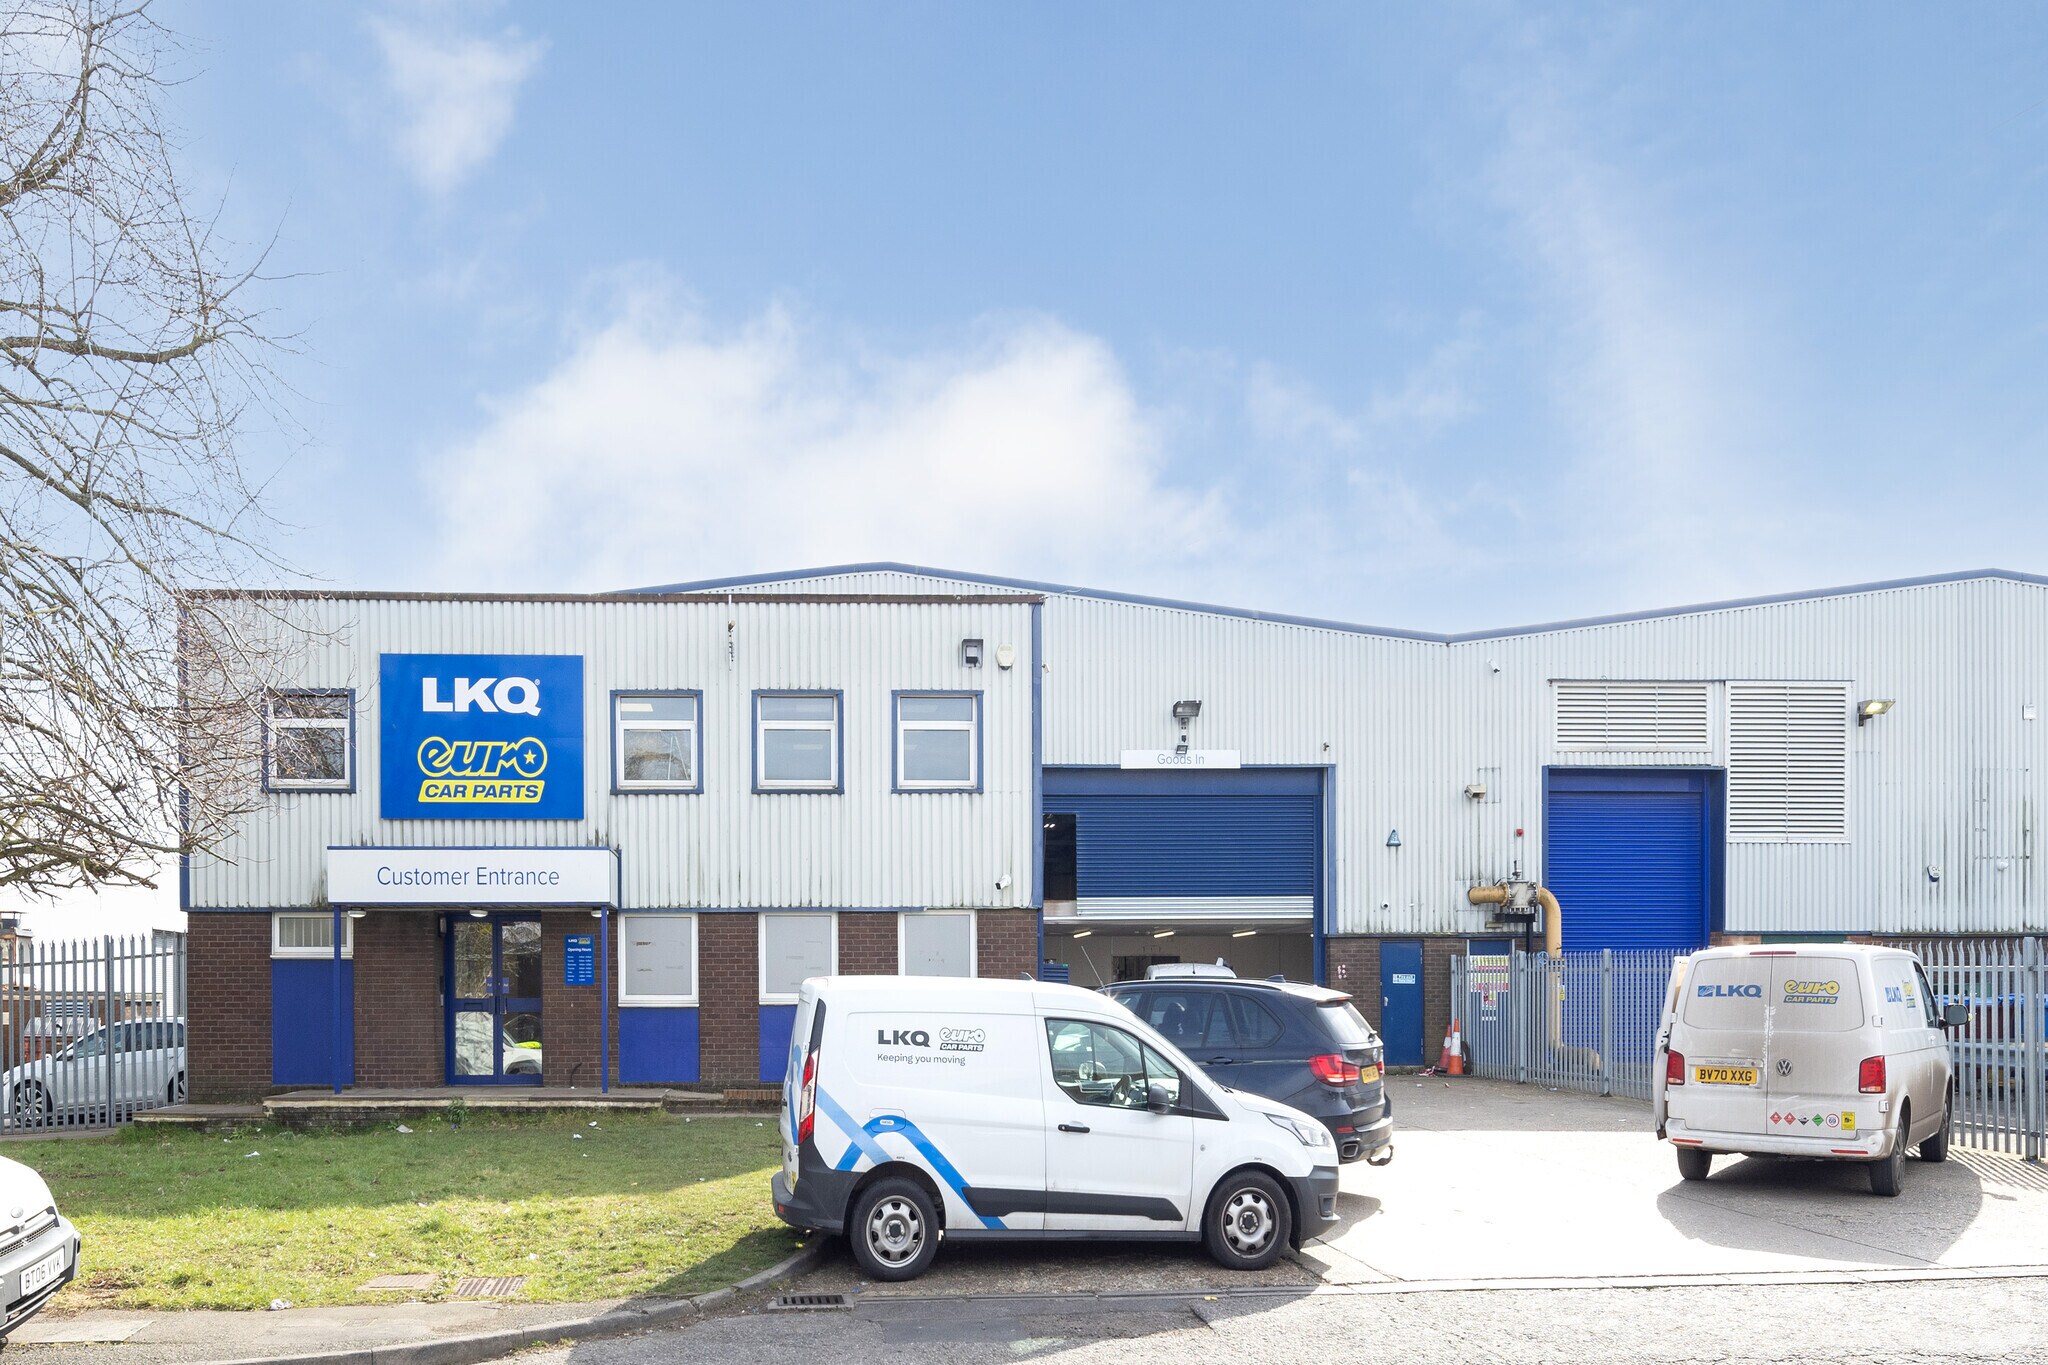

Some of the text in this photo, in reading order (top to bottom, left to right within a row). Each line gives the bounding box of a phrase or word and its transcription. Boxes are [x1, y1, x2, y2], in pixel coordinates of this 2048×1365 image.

[422, 676, 542, 717] LKQ
[417, 736, 548, 778] euro
[1156, 753, 1205, 765] Goods In
[424, 784, 539, 799] CAR PARTS
[377, 866, 560, 886] Customer Entrance
[1715, 984, 1763, 998] LKQ
[1783, 979, 1840, 995] euro
[1805, 996, 1836, 1004] PARTS
[877, 1029, 931, 1048] LKQ
[939, 1027, 986, 1043] euro
[941, 1043, 983, 1052] CAR PARTS
[877, 1053, 966, 1067] Keeping you moving
[1699, 1069, 1752, 1082] BV70 XXG
